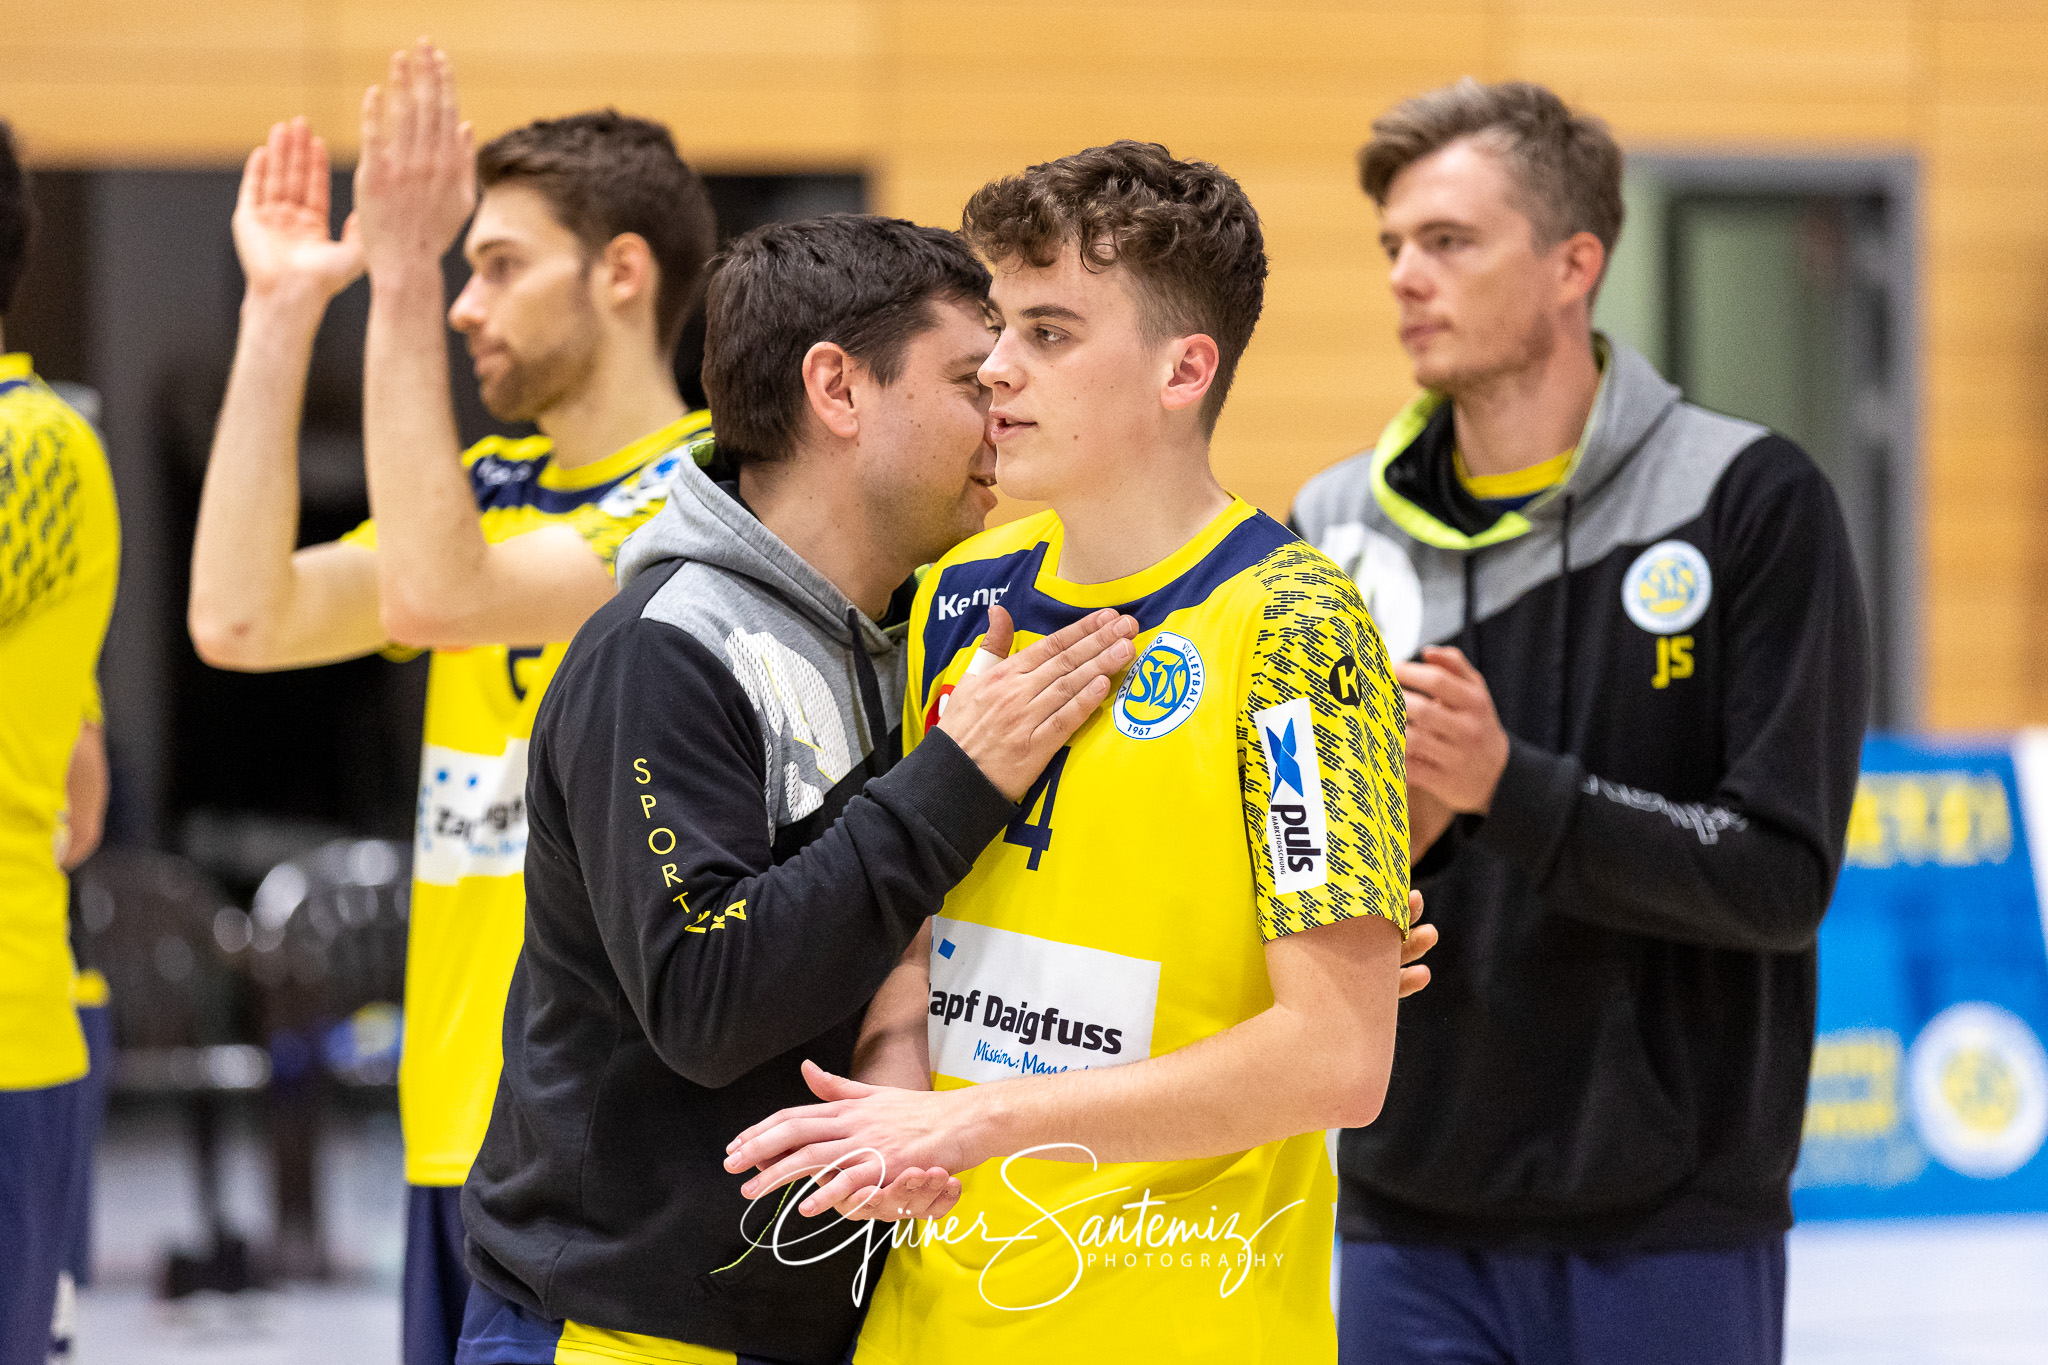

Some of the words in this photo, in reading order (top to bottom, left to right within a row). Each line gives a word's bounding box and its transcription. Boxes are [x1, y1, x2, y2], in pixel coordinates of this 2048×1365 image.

[1651, 635, 1695, 689] JS
[1127, 723, 1152, 736] 1967
[1002, 744, 1072, 872] 4
[1270, 803, 1322, 874] puls
[1271, 815, 1287, 876] MARKTFORSCHUNG
[927, 983, 981, 1027] apf
[983, 994, 1123, 1056] Daigfuss
[973, 1038, 1020, 1069] Mission:
